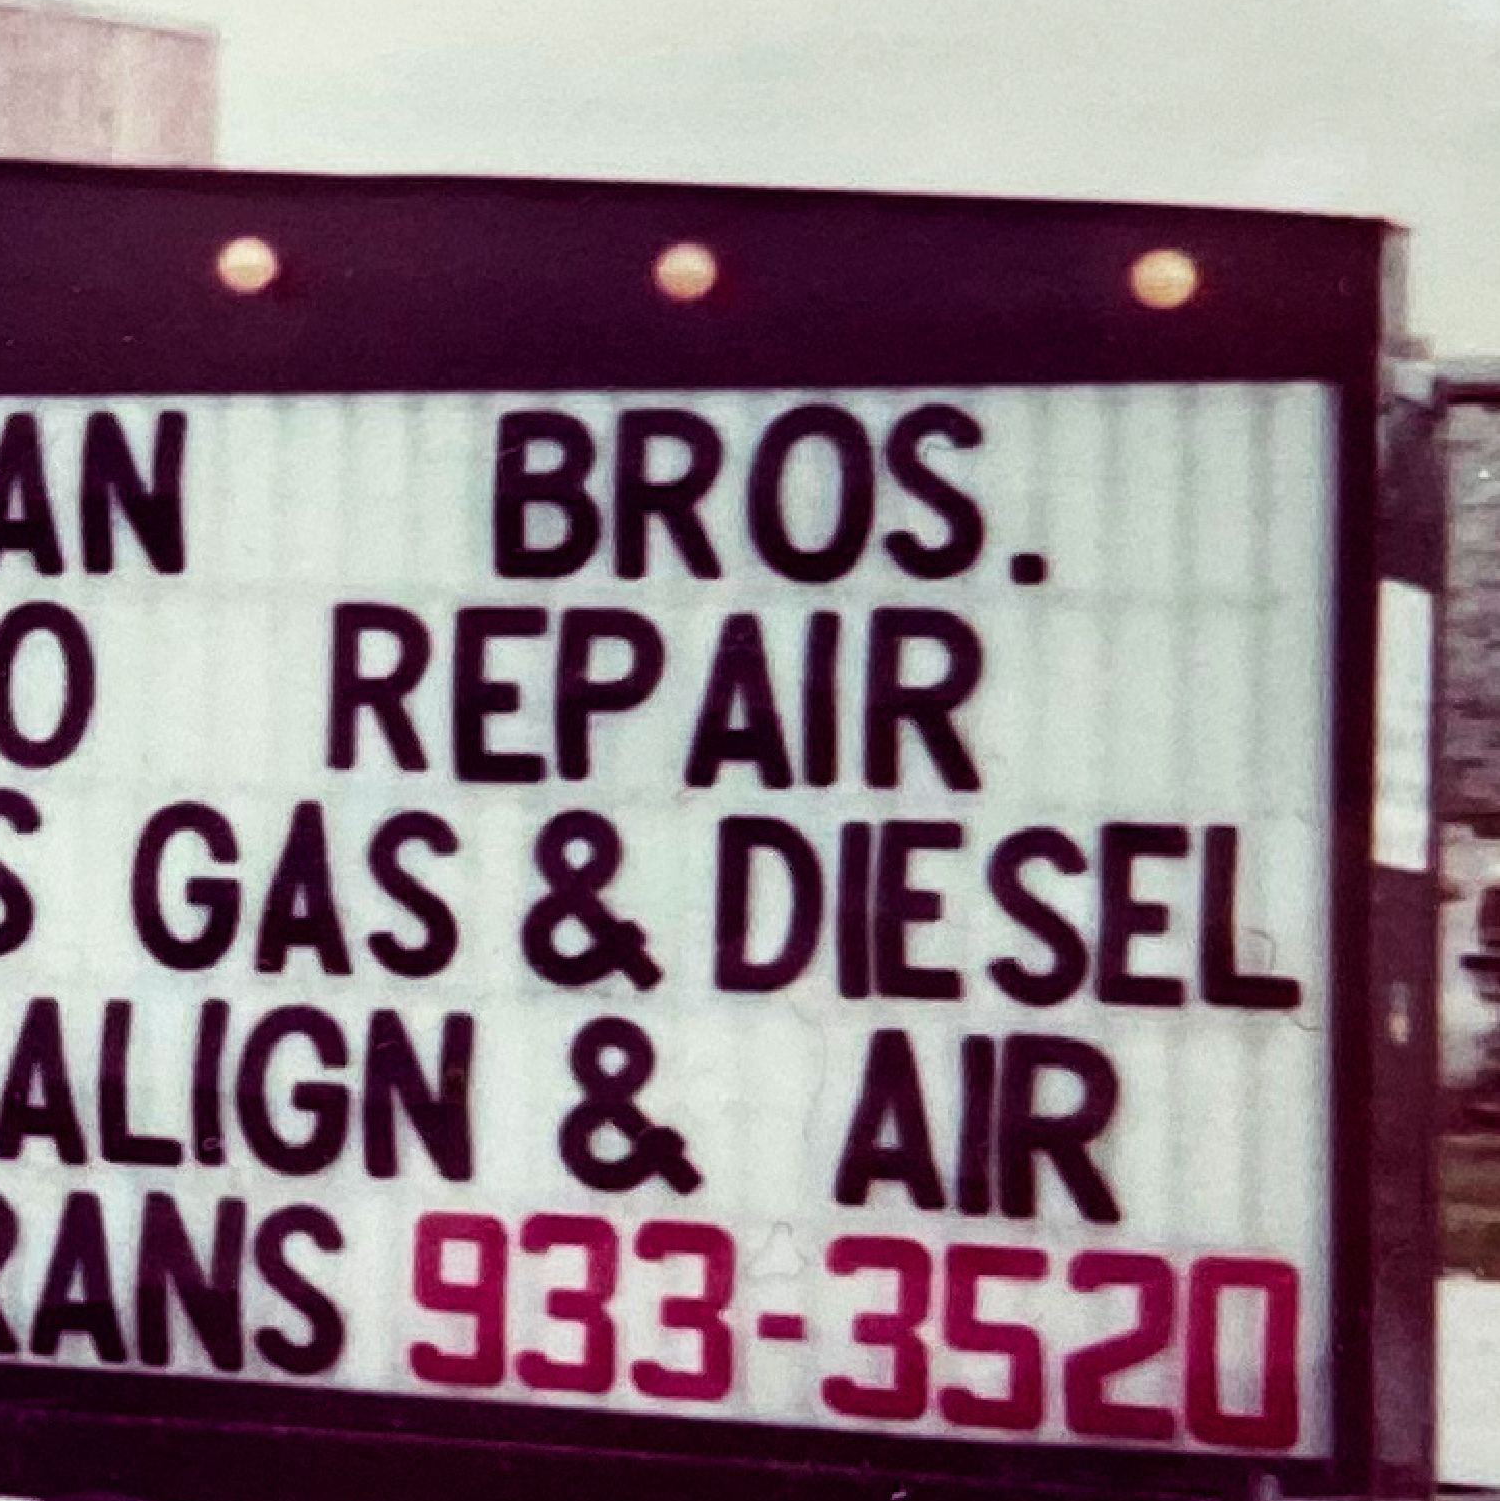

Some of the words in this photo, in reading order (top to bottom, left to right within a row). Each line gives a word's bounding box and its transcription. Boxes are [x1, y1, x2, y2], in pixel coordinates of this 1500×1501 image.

[493, 403, 1047, 585] BROS.
[326, 602, 982, 791] REPAIR
[131, 801, 459, 976] GAS
[521, 809, 663, 990] &
[715, 815, 1300, 1009] DIESEL
[559, 1016, 702, 1195] &
[835, 1029, 1120, 1223] AIR
[410, 1212, 1300, 1450] 933-3520
